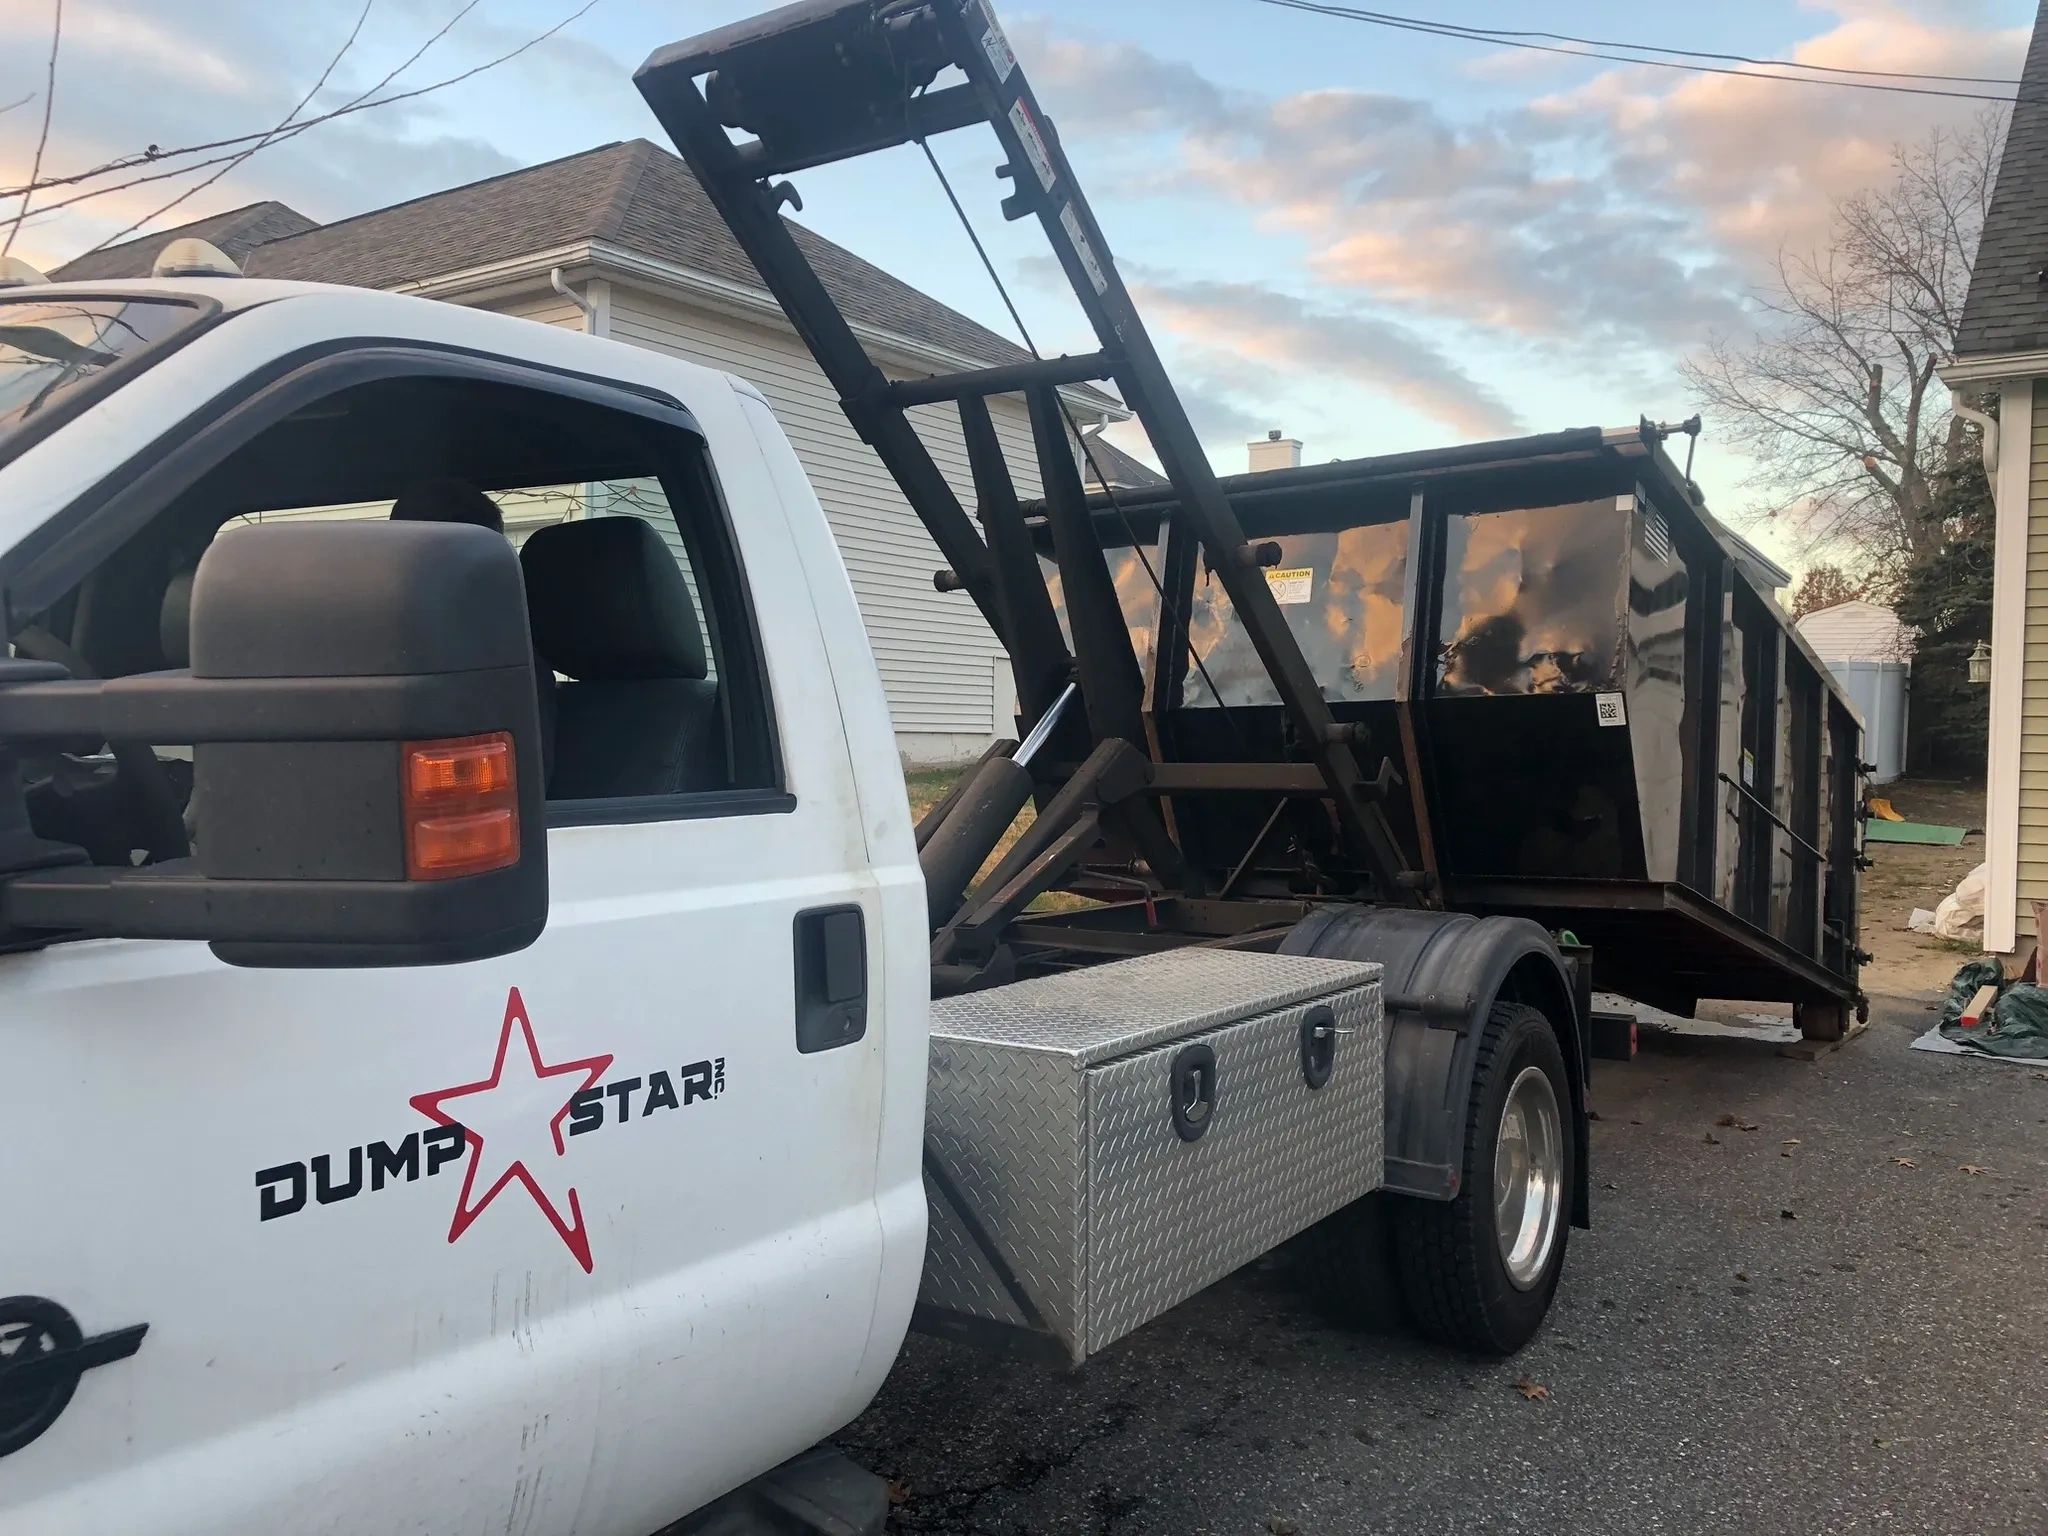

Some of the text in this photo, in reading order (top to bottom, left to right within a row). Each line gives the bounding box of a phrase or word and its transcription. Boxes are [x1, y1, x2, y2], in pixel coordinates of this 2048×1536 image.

[1275, 570, 1311, 579] CAUTION
[255, 1060, 713, 1222] DUMP STAR
